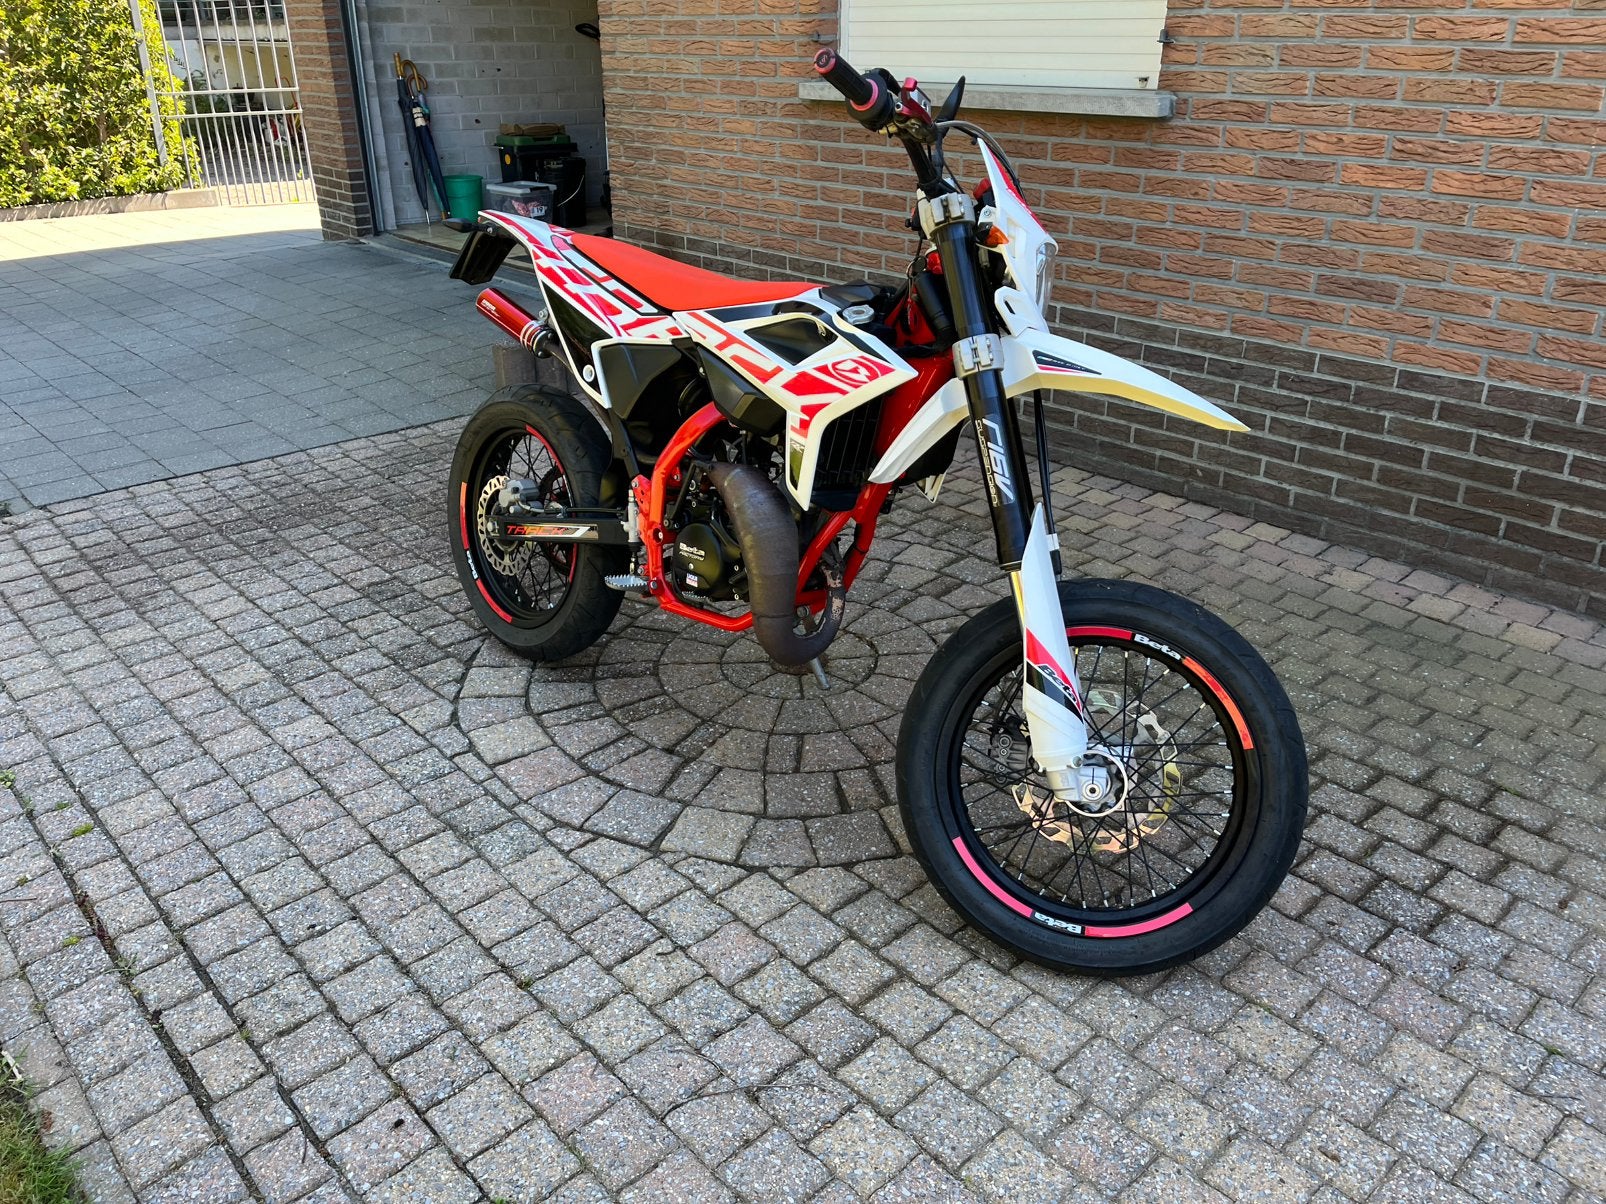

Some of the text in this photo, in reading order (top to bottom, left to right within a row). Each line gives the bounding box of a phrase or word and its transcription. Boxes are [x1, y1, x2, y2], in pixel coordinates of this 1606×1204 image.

[1134, 633, 1181, 660] Beta
[1037, 664, 1078, 703] Beta
[1034, 911, 1082, 934] Beta
